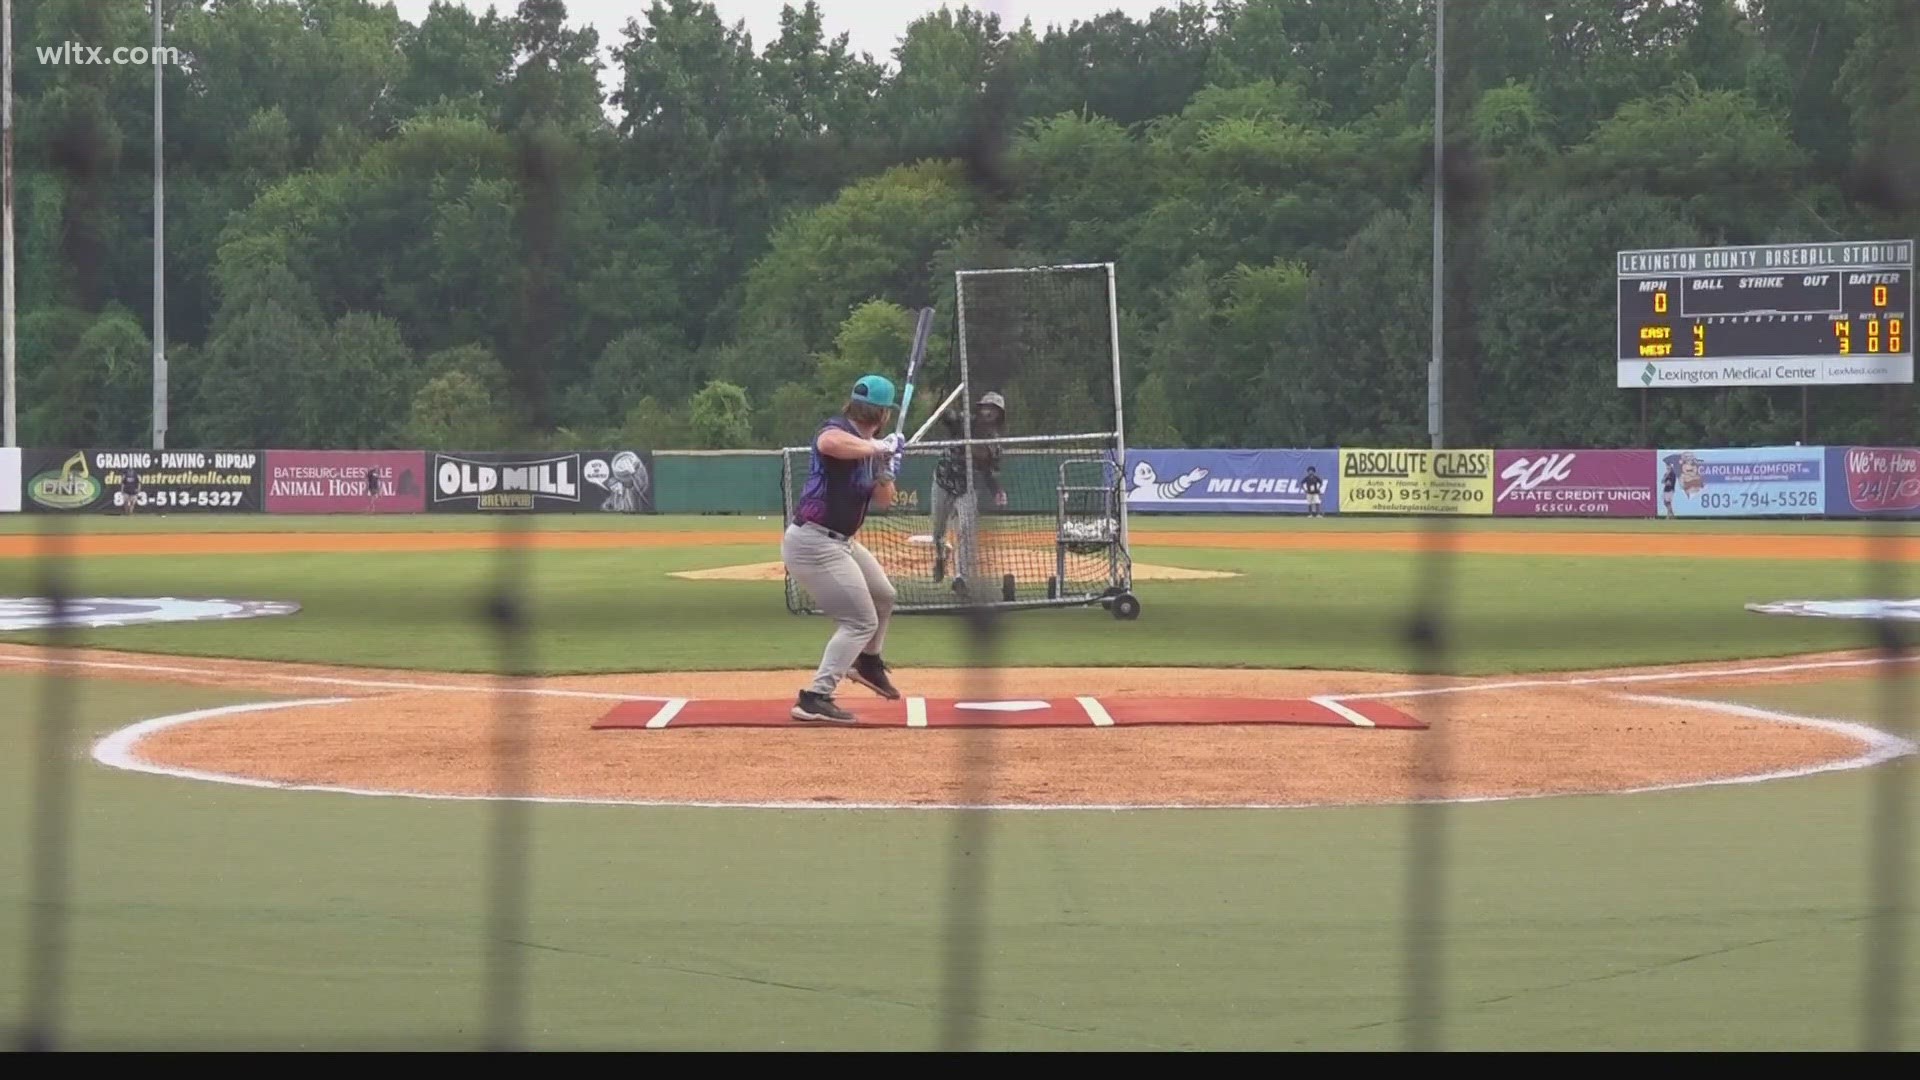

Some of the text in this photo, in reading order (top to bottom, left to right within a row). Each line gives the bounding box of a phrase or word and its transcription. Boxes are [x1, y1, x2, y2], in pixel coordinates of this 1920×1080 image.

[1622, 245, 1908, 272] LEXINGTON COUNTY BASEBALL STADIUM
[1639, 281, 1667, 292] MPH
[1693, 275, 1829, 290] BALL STRIKE OUT
[1849, 273, 1899, 285] BATTER
[1655, 292, 1667, 312] 0
[1874, 286, 1887, 306] 0
[1640, 319, 1900, 339] EAST 4 14 0 0
[1639, 337, 1900, 356] WEST 3 3 0 0
[1658, 365, 1816, 383] Lexington Medical Center
[1828, 366, 1888, 377] LexMed.com
[96, 453, 256, 468] GRADING PAVING RIPRAP
[1344, 453, 1427, 477] ABSOLUTE
[1433, 454, 1487, 478] GLASS
[1850, 451, 1917, 473] We're Here
[1698, 465, 1750, 475] CAROLINA
[1753, 463, 1802, 474] COMFORT
[104, 470, 251, 485] dnnstructionllc.com
[439, 462, 497, 494] OLD
[503, 461, 575, 495] MILL
[42, 481, 88, 495] DNR
[270, 480, 396, 496] ANIMAL HOSPAL
[1349, 488, 1484, 502] (803) 951-7200
[1510, 491, 1650, 500] STATE CREDIT UNION
[1855, 476, 1902, 504] 24/7
[113, 491, 243, 506] 83-513-5327
[481, 494, 531, 507] BREWPUB
[1701, 491, 1817, 508] 803-794-5526
[1535, 503, 1608, 512] scscu.com
